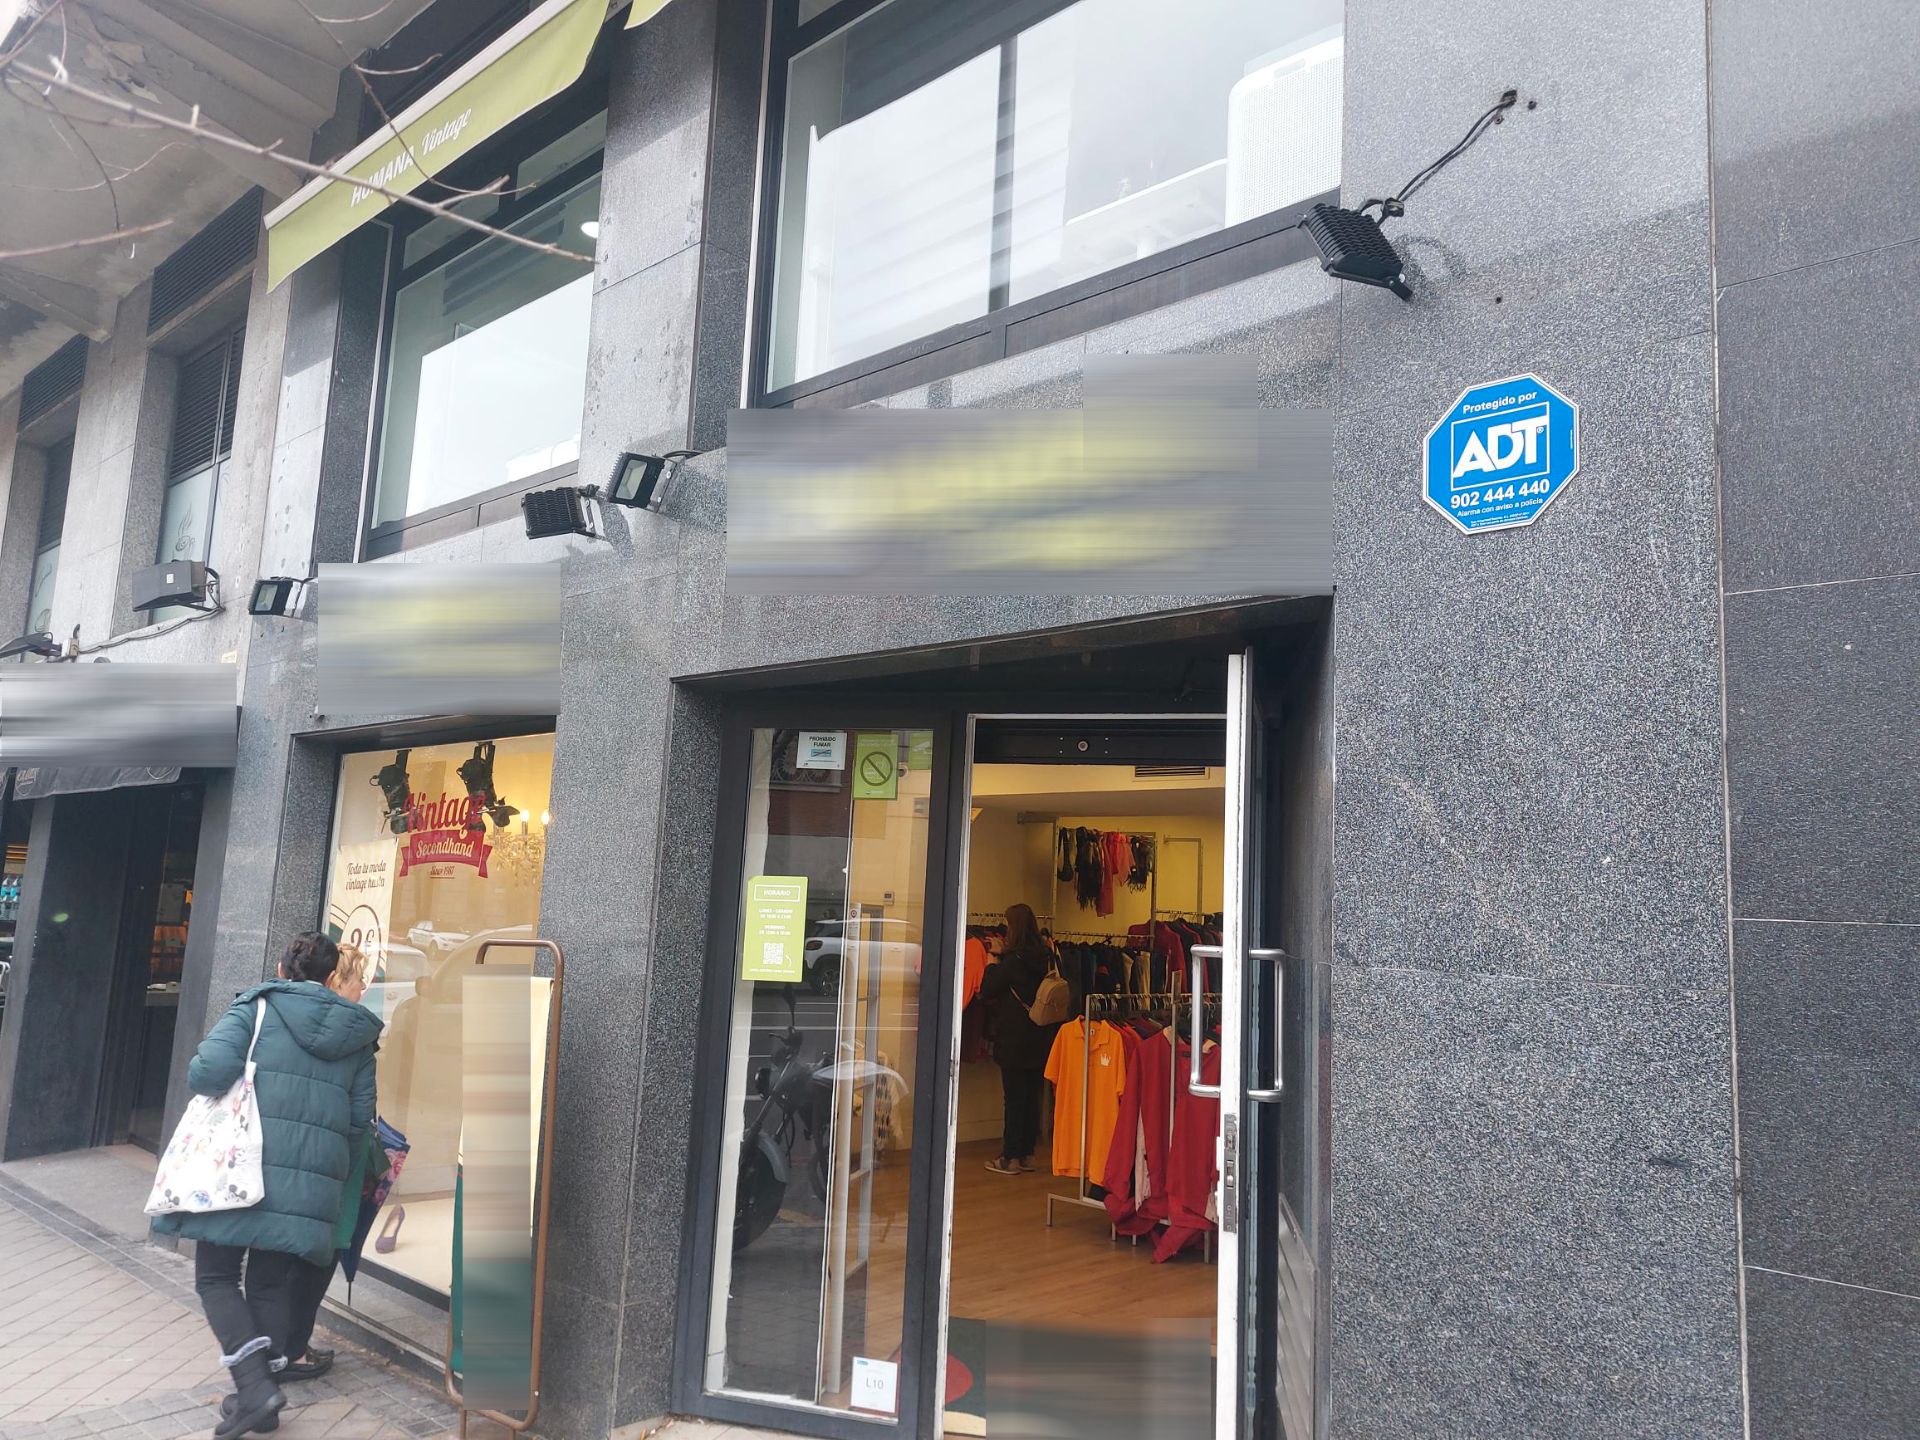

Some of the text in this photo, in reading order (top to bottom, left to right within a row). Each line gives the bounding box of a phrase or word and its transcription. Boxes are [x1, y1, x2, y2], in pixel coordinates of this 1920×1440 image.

[350, 108, 472, 208] HUMANA Vintage
[1462, 391, 1538, 415] Protegido por
[1451, 478, 1550, 509] 902 444 440
[1456, 507, 1481, 518] Alarma
[1481, 506, 1495, 514] con
[1495, 502, 1514, 511] aviso
[403, 791, 486, 840] Vintage
[416, 837, 475, 858] Secondhand
[347, 860, 387, 876] Toda tu moda
[345, 875, 386, 893] vintage hasta
